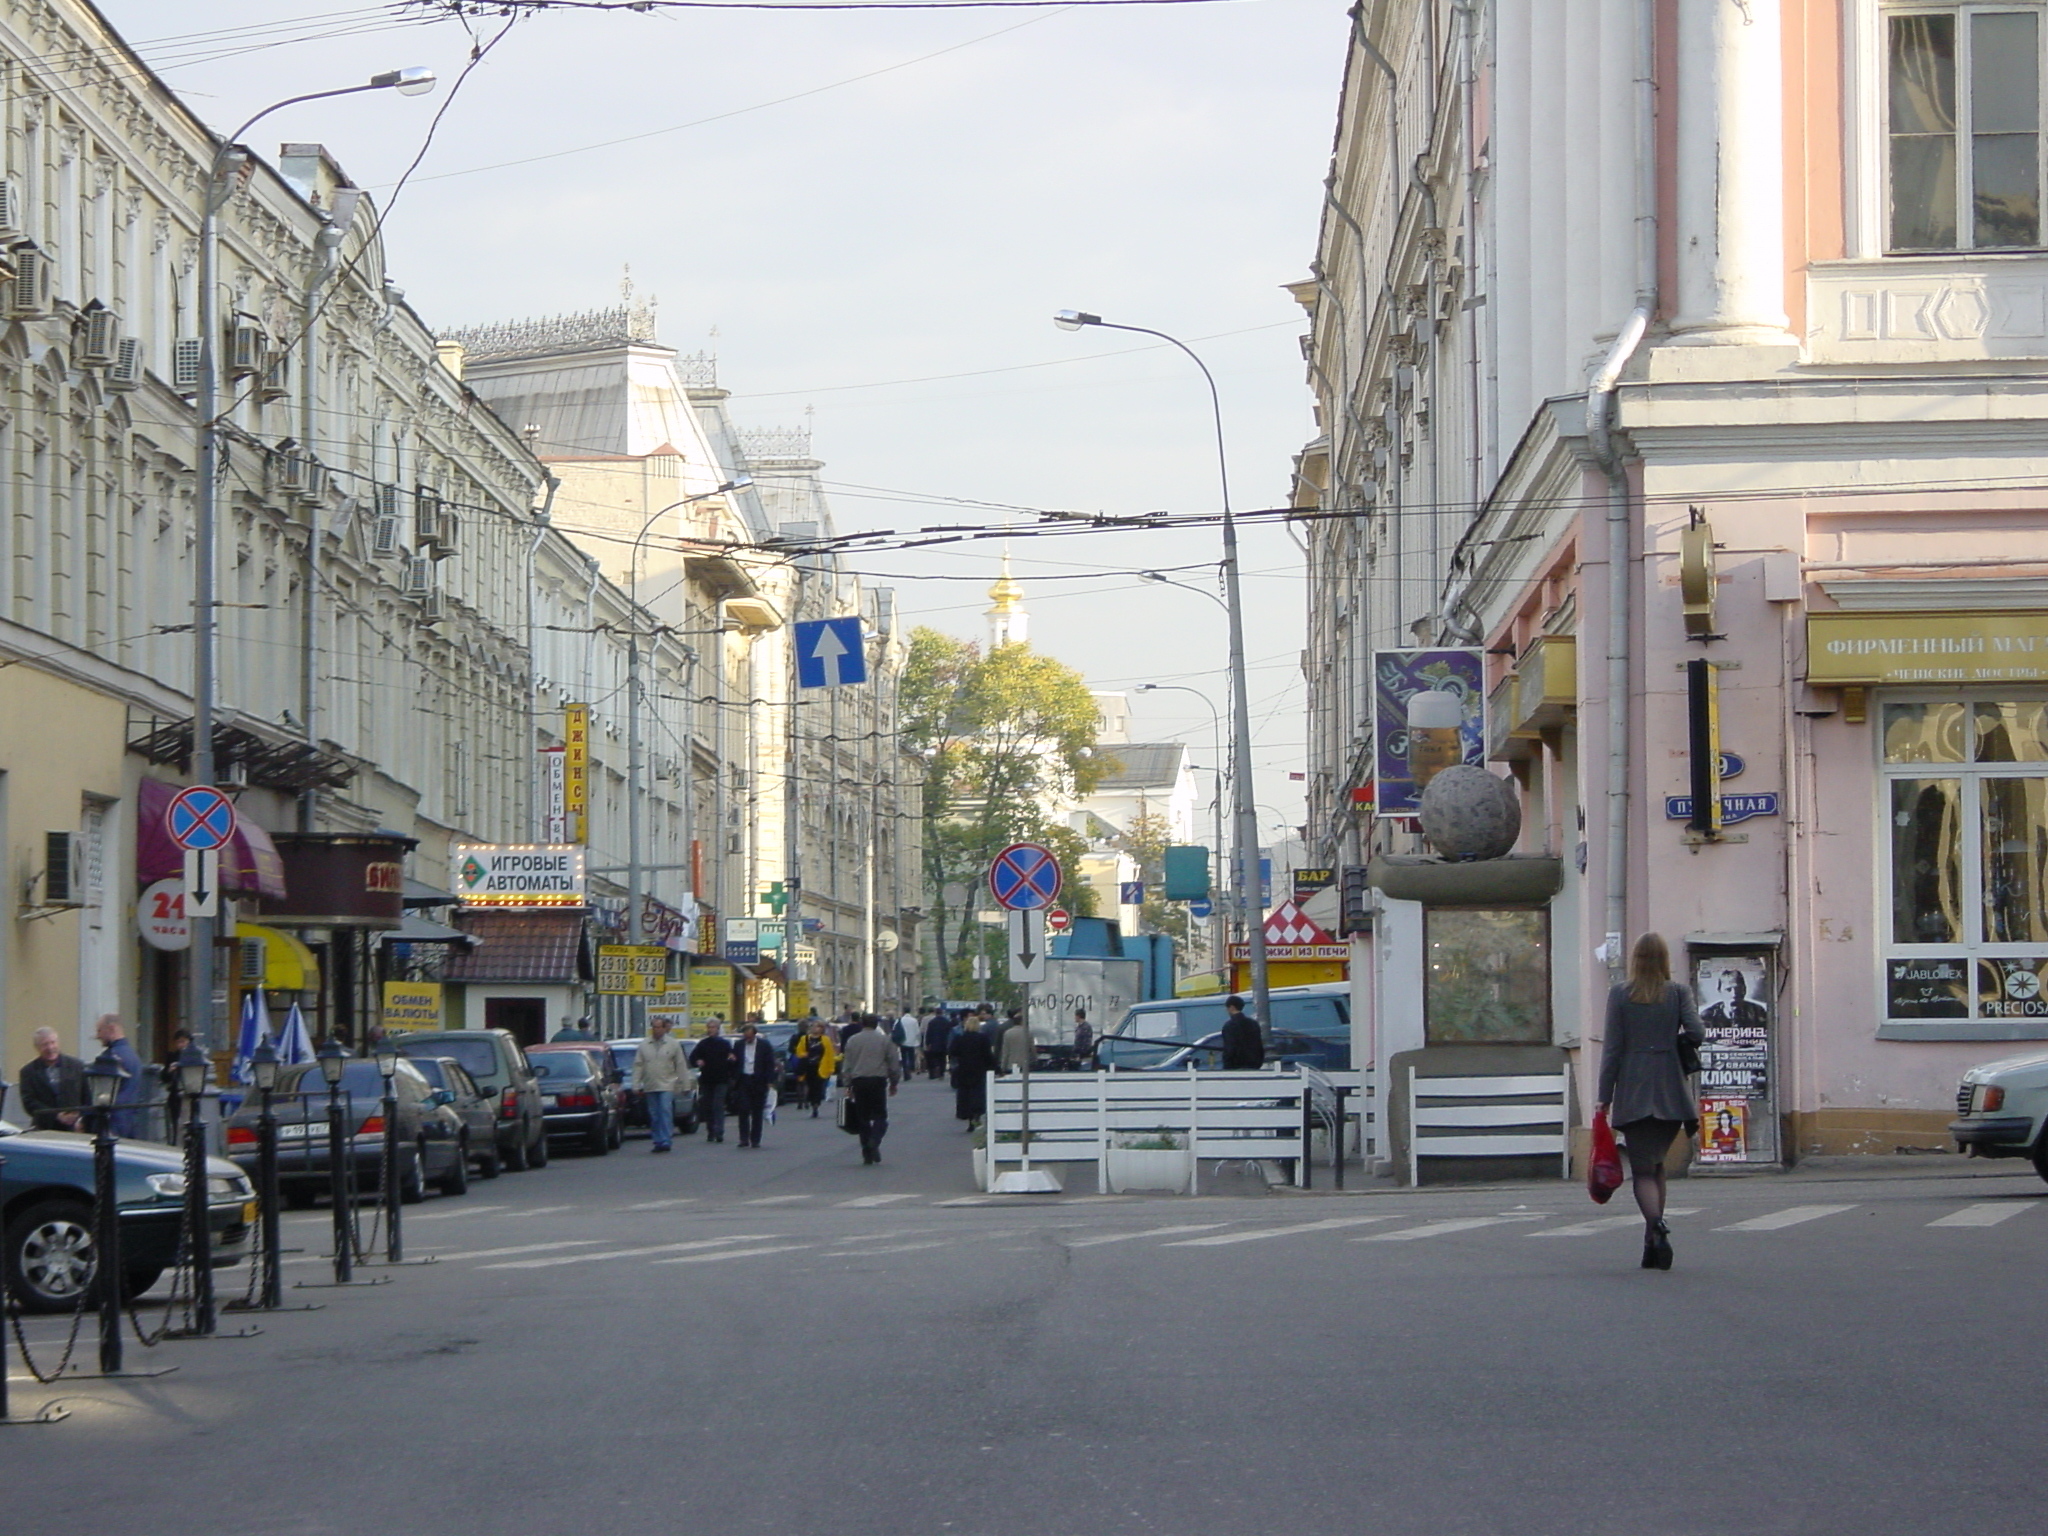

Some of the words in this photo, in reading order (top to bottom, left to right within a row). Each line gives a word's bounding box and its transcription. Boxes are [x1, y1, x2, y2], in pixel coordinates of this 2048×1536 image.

[1826, 631, 1984, 655] ФИРМЕННЫЙ
[1993, 636, 2048, 651] МАГ
[572, 709, 584, 816] ДЖИНСЫ
[552, 756, 563, 815] ОБМЕН
[1677, 798, 1767, 813] ПЧНАЯ
[491, 855, 568, 872] ИГРОВЫЕ
[486, 875, 574, 892] АВТОМАТЫ
[1297, 870, 1331, 882] БАР
[152, 891, 185, 920] 24
[1235, 947, 1293, 957] ПИЖКИ
[1298, 947, 1312, 957] ИЗ
[1318, 947, 1347, 957] ПЕЧИ
[392, 995, 433, 1006] ОБМЕН
[1064, 993, 1093, 1011] 901
[385, 1008, 438, 1019] ВАЛЮТЫ
[1701, 1070, 1752, 1085] КЛЮЧИ
